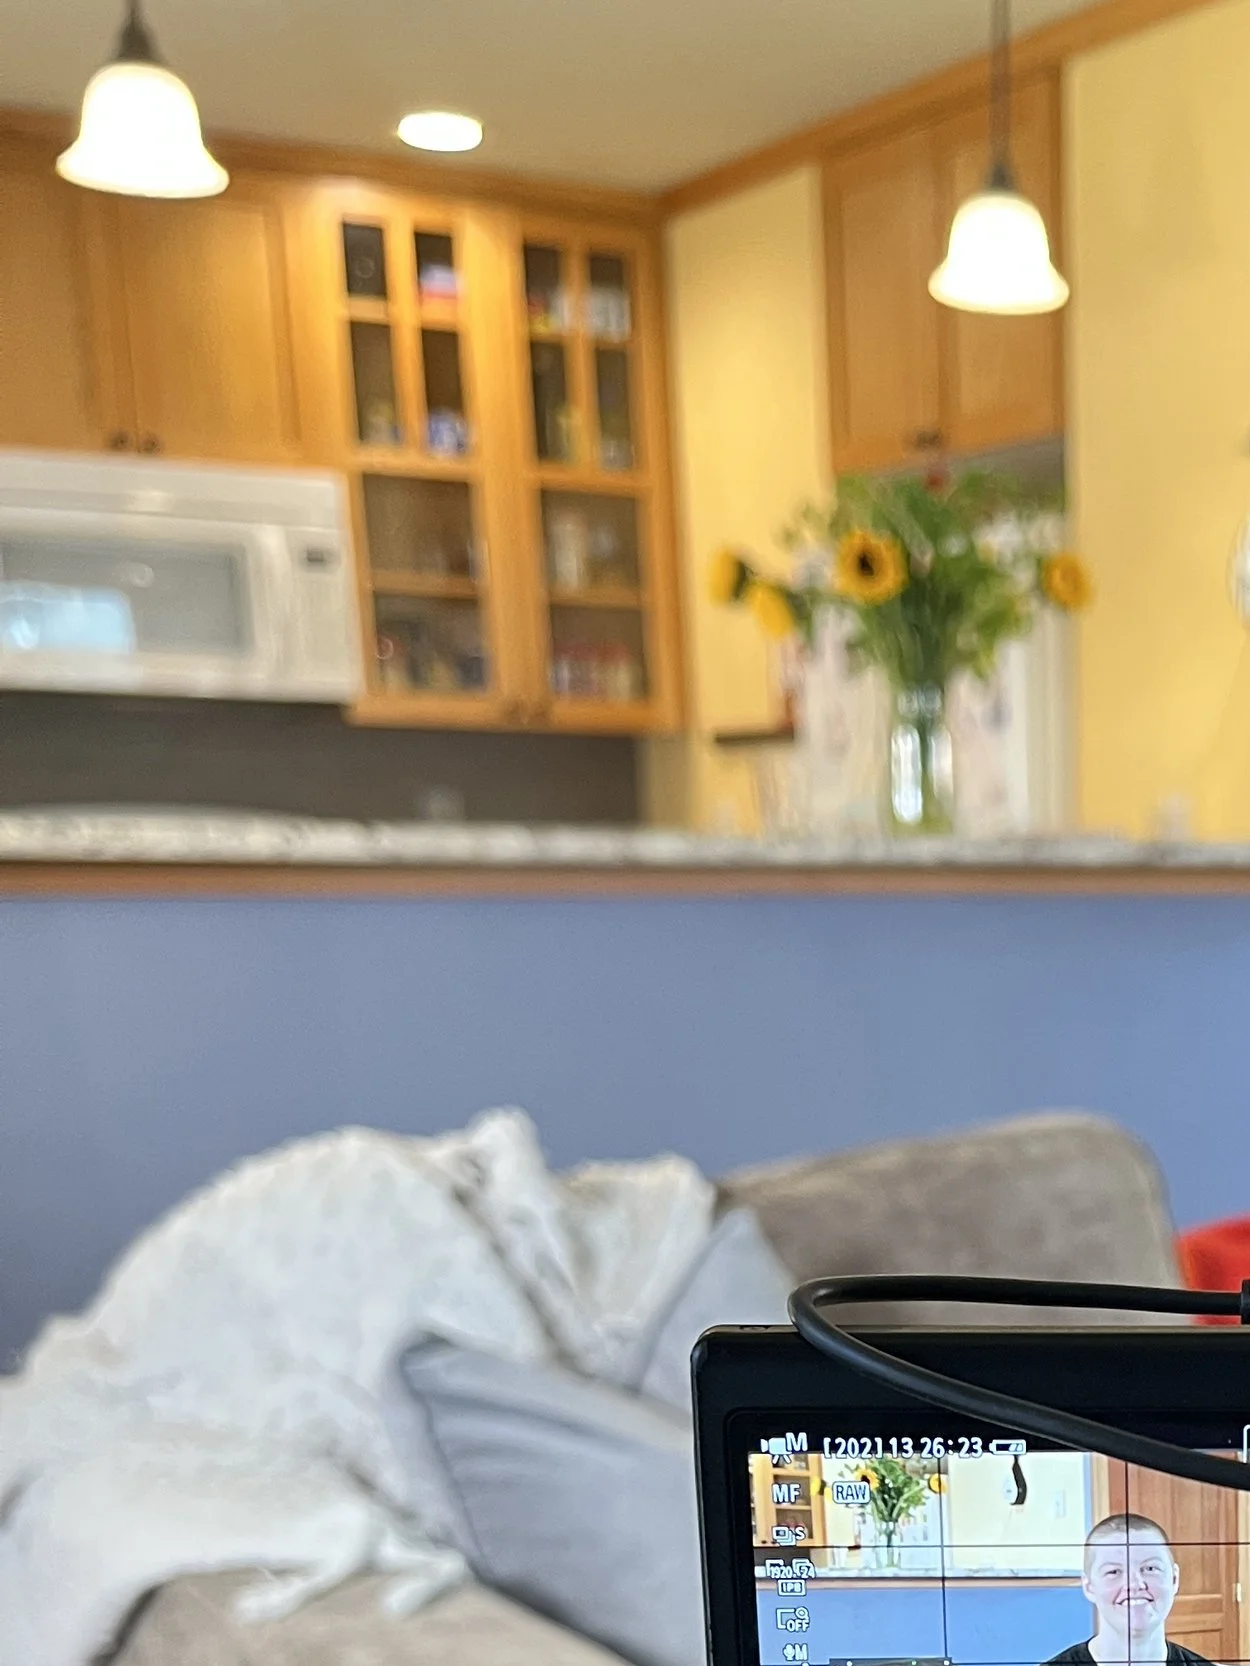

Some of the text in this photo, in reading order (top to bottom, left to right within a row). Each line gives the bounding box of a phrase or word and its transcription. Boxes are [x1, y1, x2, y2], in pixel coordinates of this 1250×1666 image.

[786, 1432, 808, 1452] M
[772, 1484, 800, 1502] MF
[835, 1483, 867, 1500] RAW
[786, 1620, 810, 1632] OFF
[795, 1644, 808, 1660] M
